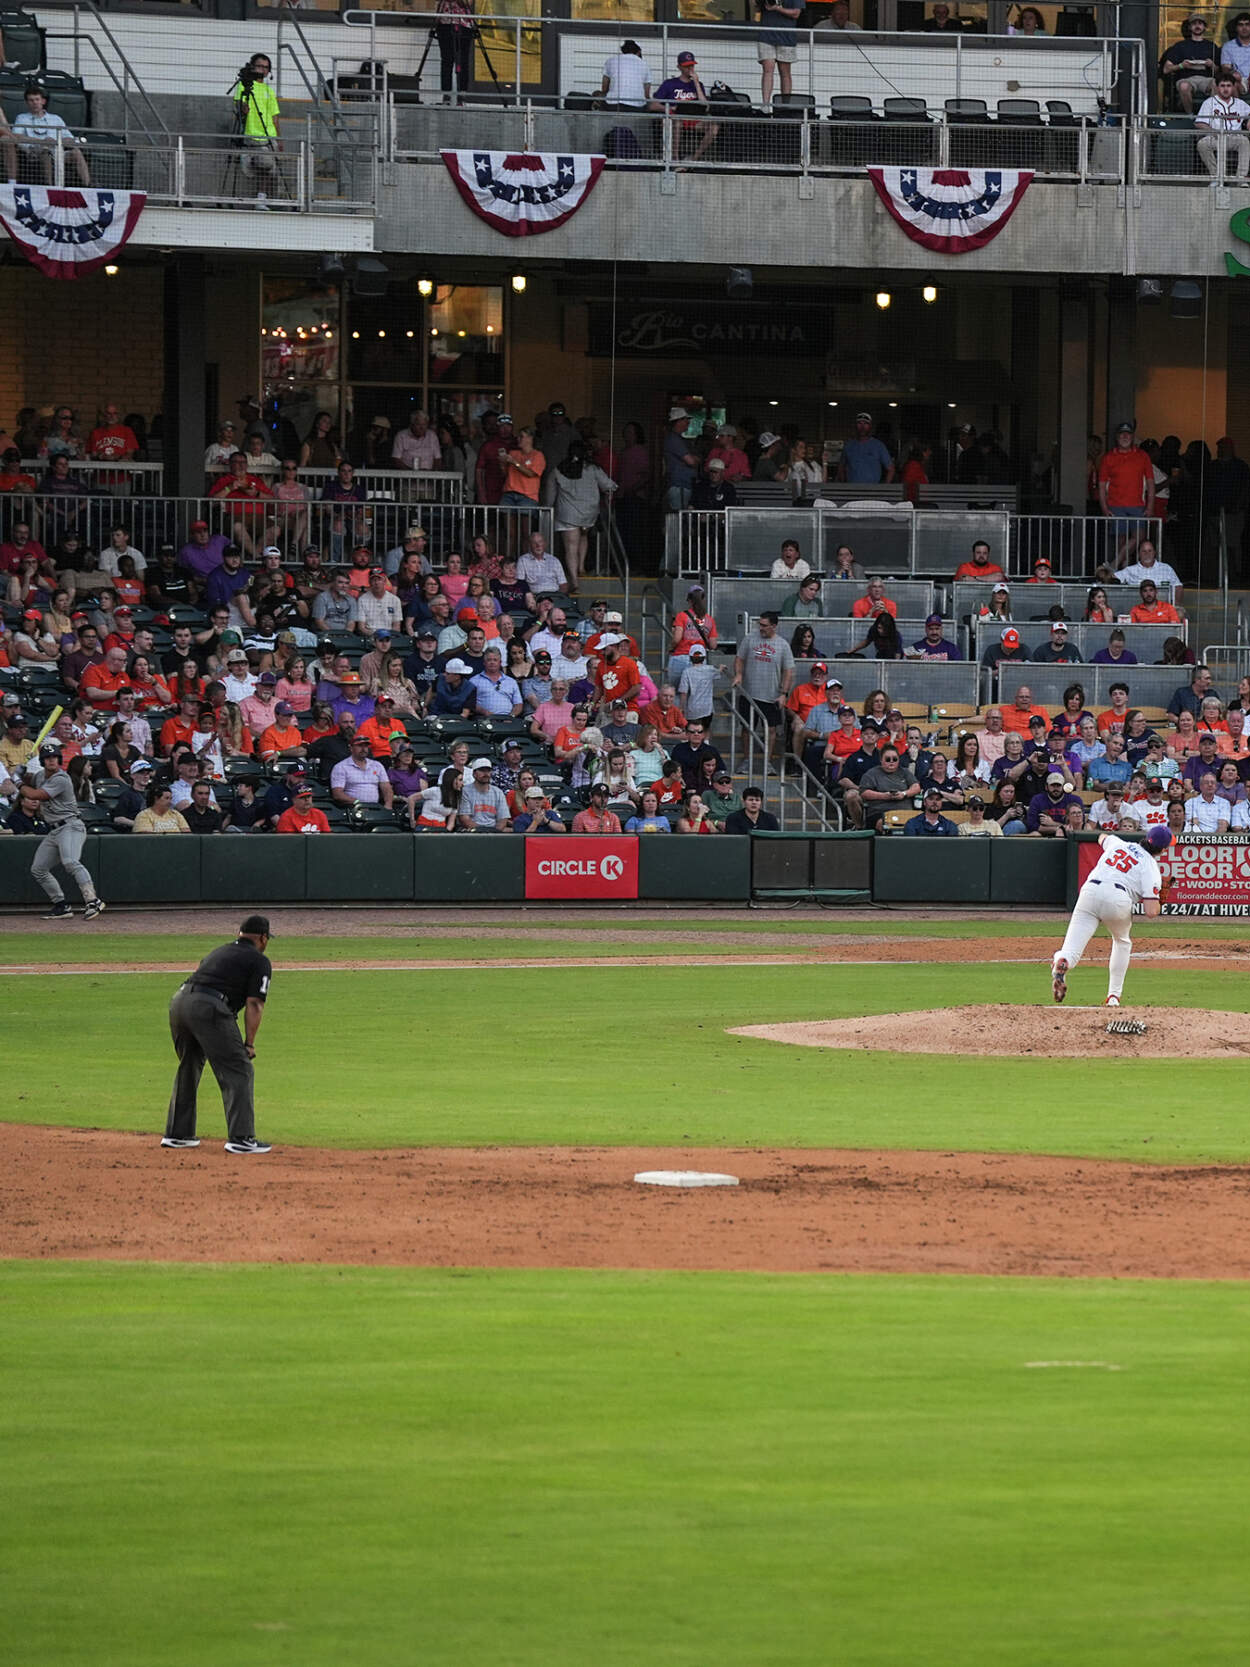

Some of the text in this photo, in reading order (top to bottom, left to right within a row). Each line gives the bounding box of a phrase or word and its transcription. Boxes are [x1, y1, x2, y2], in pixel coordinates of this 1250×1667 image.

[691, 323, 806, 342] CANTINA
[538, 857, 622, 879] CIRCLE K
[1105, 849, 1139, 874] 35
[1187, 881, 1222, 889] WOOD
[1177, 892, 1248, 901] flooranddecor.com
[1171, 903, 1200, 915] 24/7
[1201, 904, 1217, 916] AT
